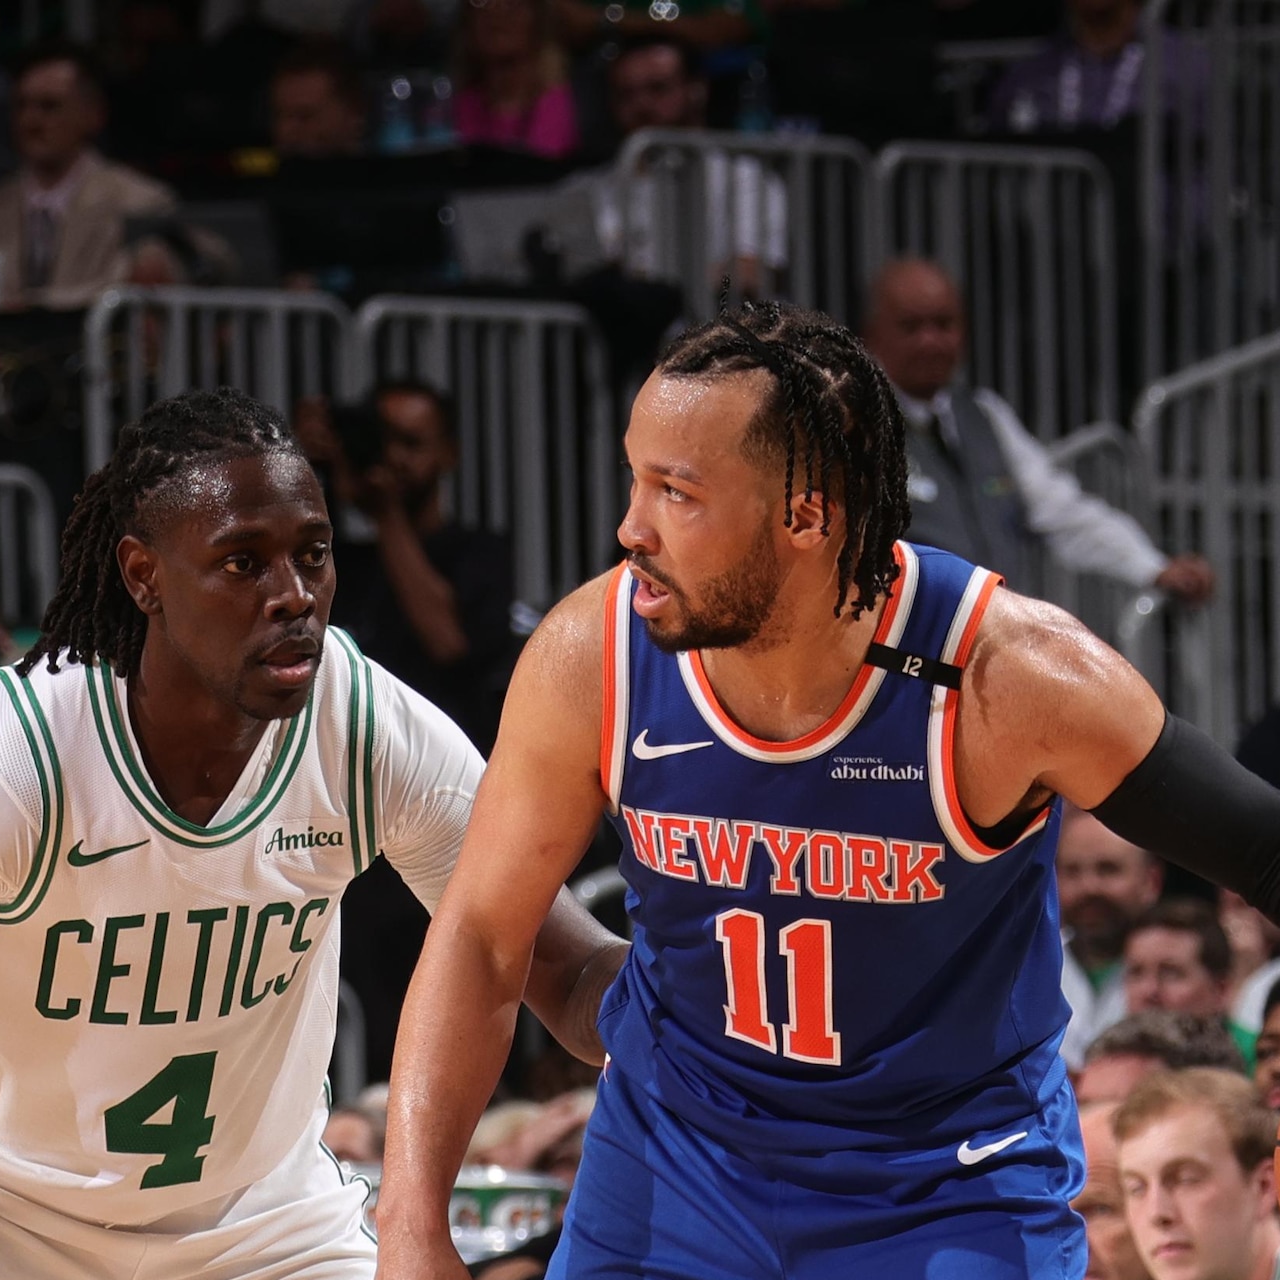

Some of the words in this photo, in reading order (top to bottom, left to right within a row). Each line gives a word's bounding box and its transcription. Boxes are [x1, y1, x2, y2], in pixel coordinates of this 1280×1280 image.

[901, 654, 924, 678] 12
[830, 764, 867, 780] abu
[870, 764, 925, 781] dhabi
[832, 756, 883, 765] experience
[264, 826, 344, 855] Amica
[620, 804, 757, 891] NEW
[760, 820, 946, 905] YORK
[35, 898, 330, 1025] CELTICS
[715, 907, 842, 1067] 11
[104, 1050, 218, 1190] 4
